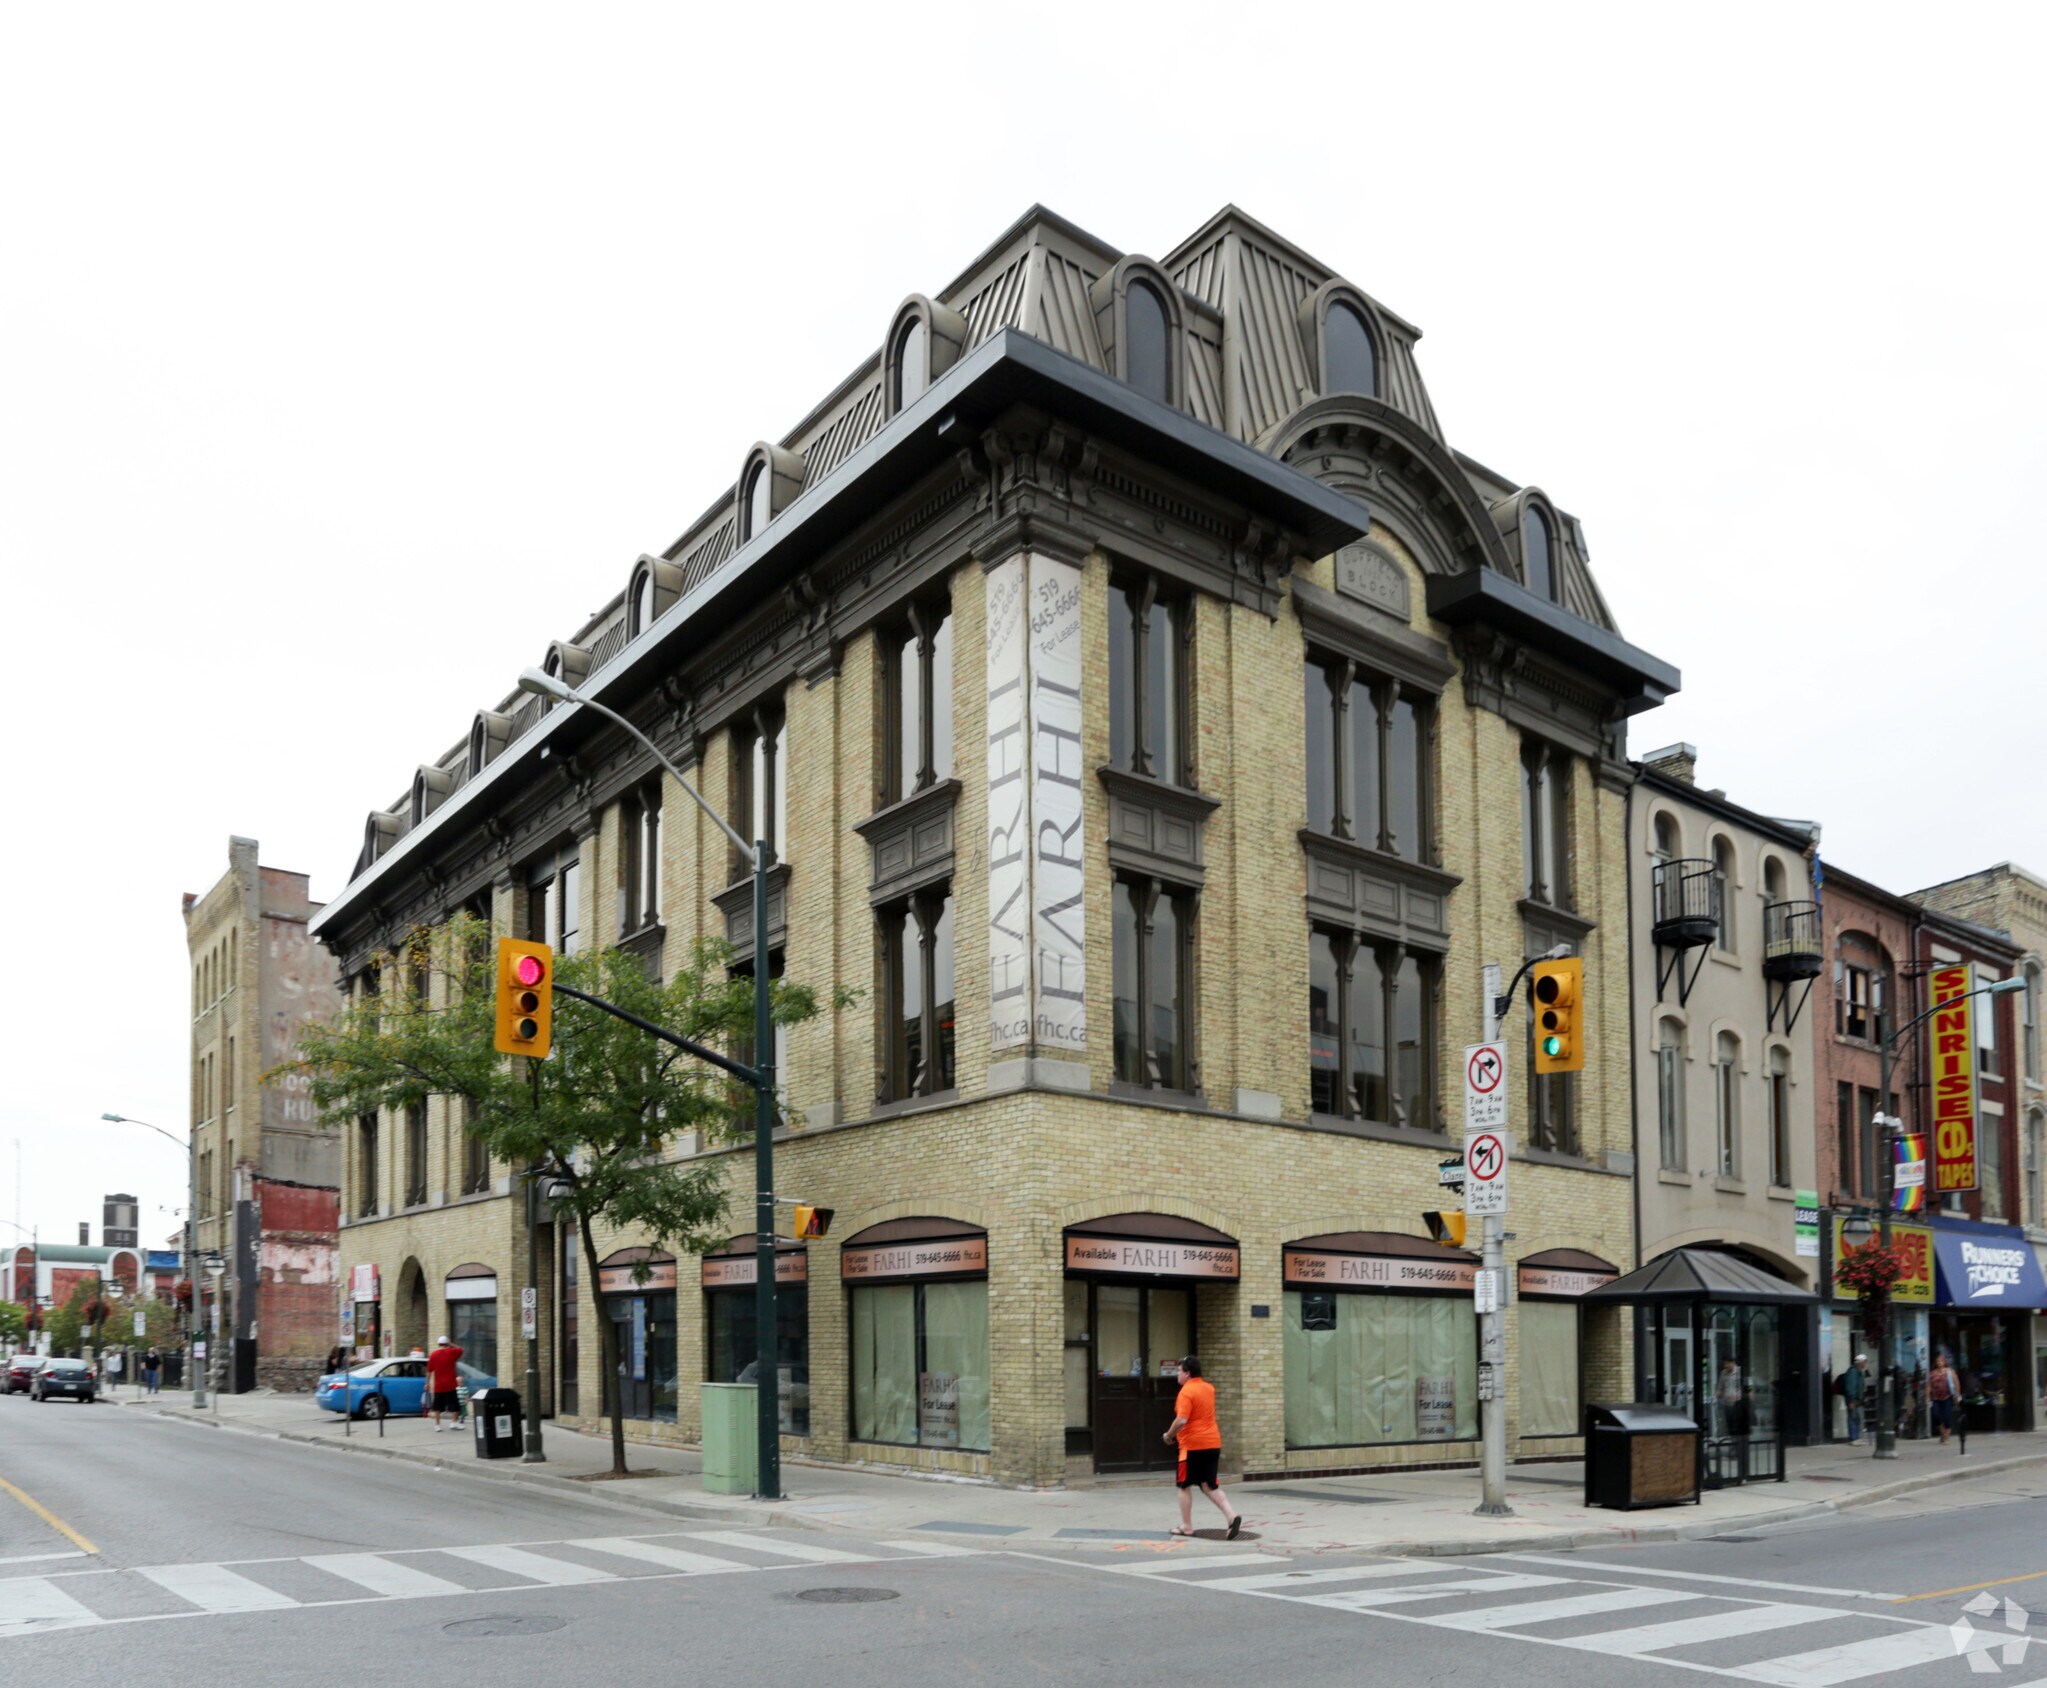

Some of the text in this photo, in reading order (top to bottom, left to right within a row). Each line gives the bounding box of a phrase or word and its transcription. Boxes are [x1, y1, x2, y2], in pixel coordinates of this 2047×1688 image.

[1039, 578, 1059, 603] 519
[1040, 620, 1080, 655] For Lease
[1036, 1014, 1087, 1042] fhc.ca
[1934, 969, 1970, 1117] SUNRISE
[1937, 1163, 1974, 1189] TAPES
[873, 1251, 911, 1271] FARHI
[916, 1250, 961, 1264] 519-645-6666
[1073, 1247, 1233, 1267] Available FARHI 519-645-6666
[724, 1263, 754, 1281] FARHI
[1212, 1263, 1233, 1274] fhc.ca
[1294, 1257, 1306, 1267] For
[1306, 1259, 1327, 1268] Lease
[1340, 1260, 1390, 1281] FARHI
[1401, 1266, 1457, 1282] 519-645-6666
[1311, 1268, 1326, 1278] Sale
[1967, 1265, 2020, 1284] CHOICE
[1550, 1274, 1585, 1291] FARHI
[1419, 1381, 1454, 1395] FARHI
[923, 1398, 956, 1411] For Lease
[1419, 1399, 1454, 1410] For Lease
